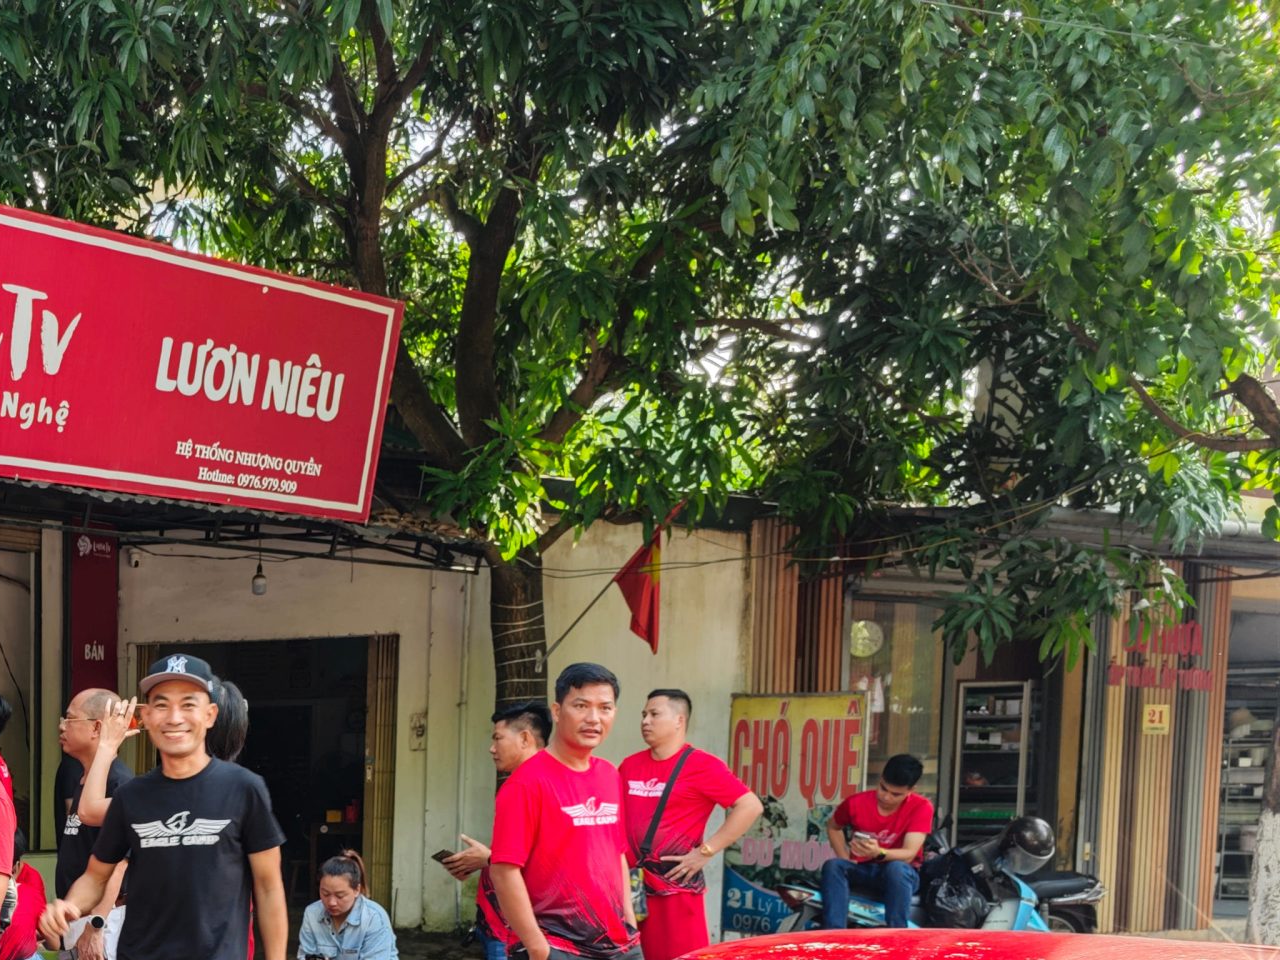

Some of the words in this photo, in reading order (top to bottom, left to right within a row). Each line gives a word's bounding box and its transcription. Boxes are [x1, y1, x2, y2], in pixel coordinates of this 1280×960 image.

[155, 336, 261, 406] LƯƠN
[261, 353, 345, 422] NIÊU
[0, 390, 71, 433] Nghệ
[175, 438, 194, 460] HỆ
[194, 441, 235, 464] THỐNG
[234, 451, 283, 471] NHƯỢNG
[284, 456, 323, 477] QUYỀN
[197, 466, 236, 485] Hotline:
[236, 472, 298, 494] 0976.979.909
[84, 640, 105, 661] BÁN
[1147, 708, 1164, 724] 21
[732, 700, 791, 801] CHÓ
[798, 699, 862, 810] QUÊ
[140, 836, 180, 849] EAGLE
[181, 835, 220, 846] CAMP
[727, 887, 755, 911] 21
[757, 897, 773, 915] Lý
[732, 913, 771, 932] 0976
